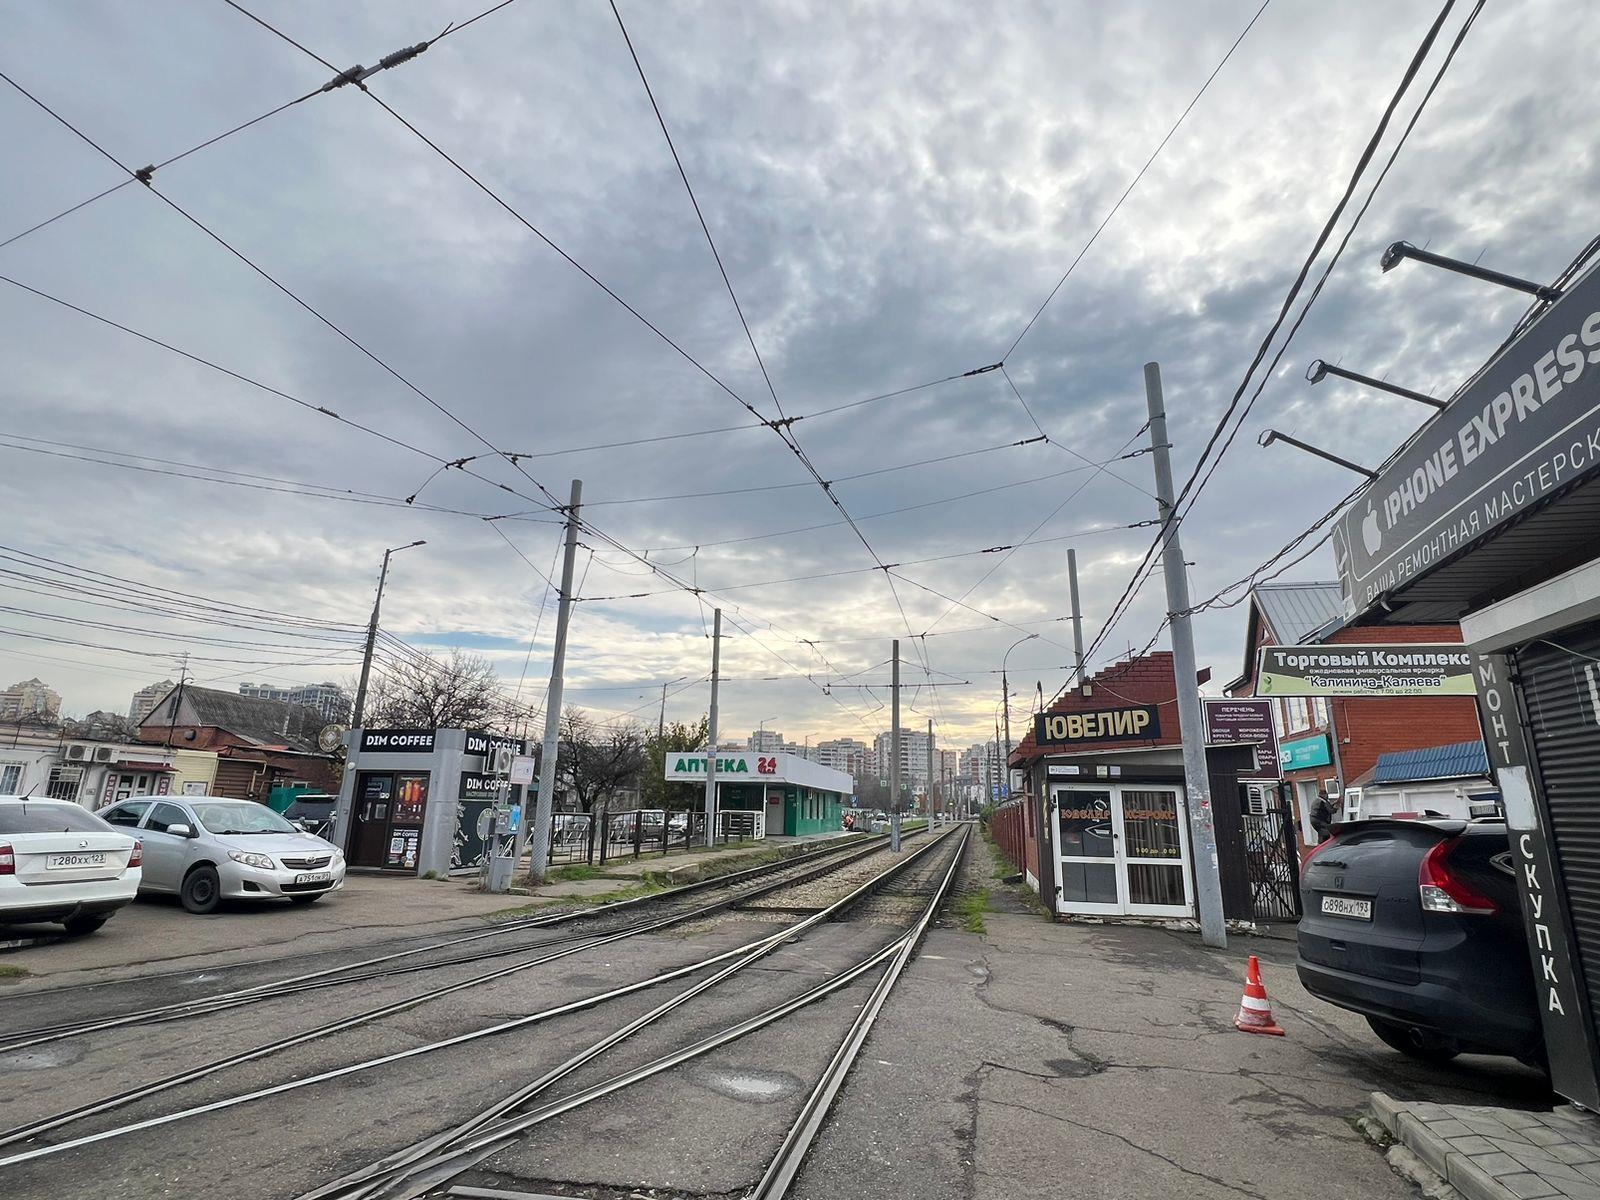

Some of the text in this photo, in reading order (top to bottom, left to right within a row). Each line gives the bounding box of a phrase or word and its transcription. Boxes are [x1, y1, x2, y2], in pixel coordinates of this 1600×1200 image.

[1383, 439, 1459, 529] IPHONE
[1366, 576, 1395, 602] ВАША
[1398, 512, 1480, 582] РЕМОНТНАЯ
[1274, 651, 1470, 669] Торговый Комплекс
[1045, 710, 1150, 740] ЮВЕЛИР
[366, 735, 433, 746] DIM COFFEE
[468, 738, 486, 751] DIM
[674, 757, 777, 774] АПТЕКА 24
[466, 778, 482, 790] DIM
[1125, 809, 1176, 820] КСЕРОКС
[1478, 654, 1565, 1016] МОНТ СКУПКА
[1355, 901, 1369, 913] 193
